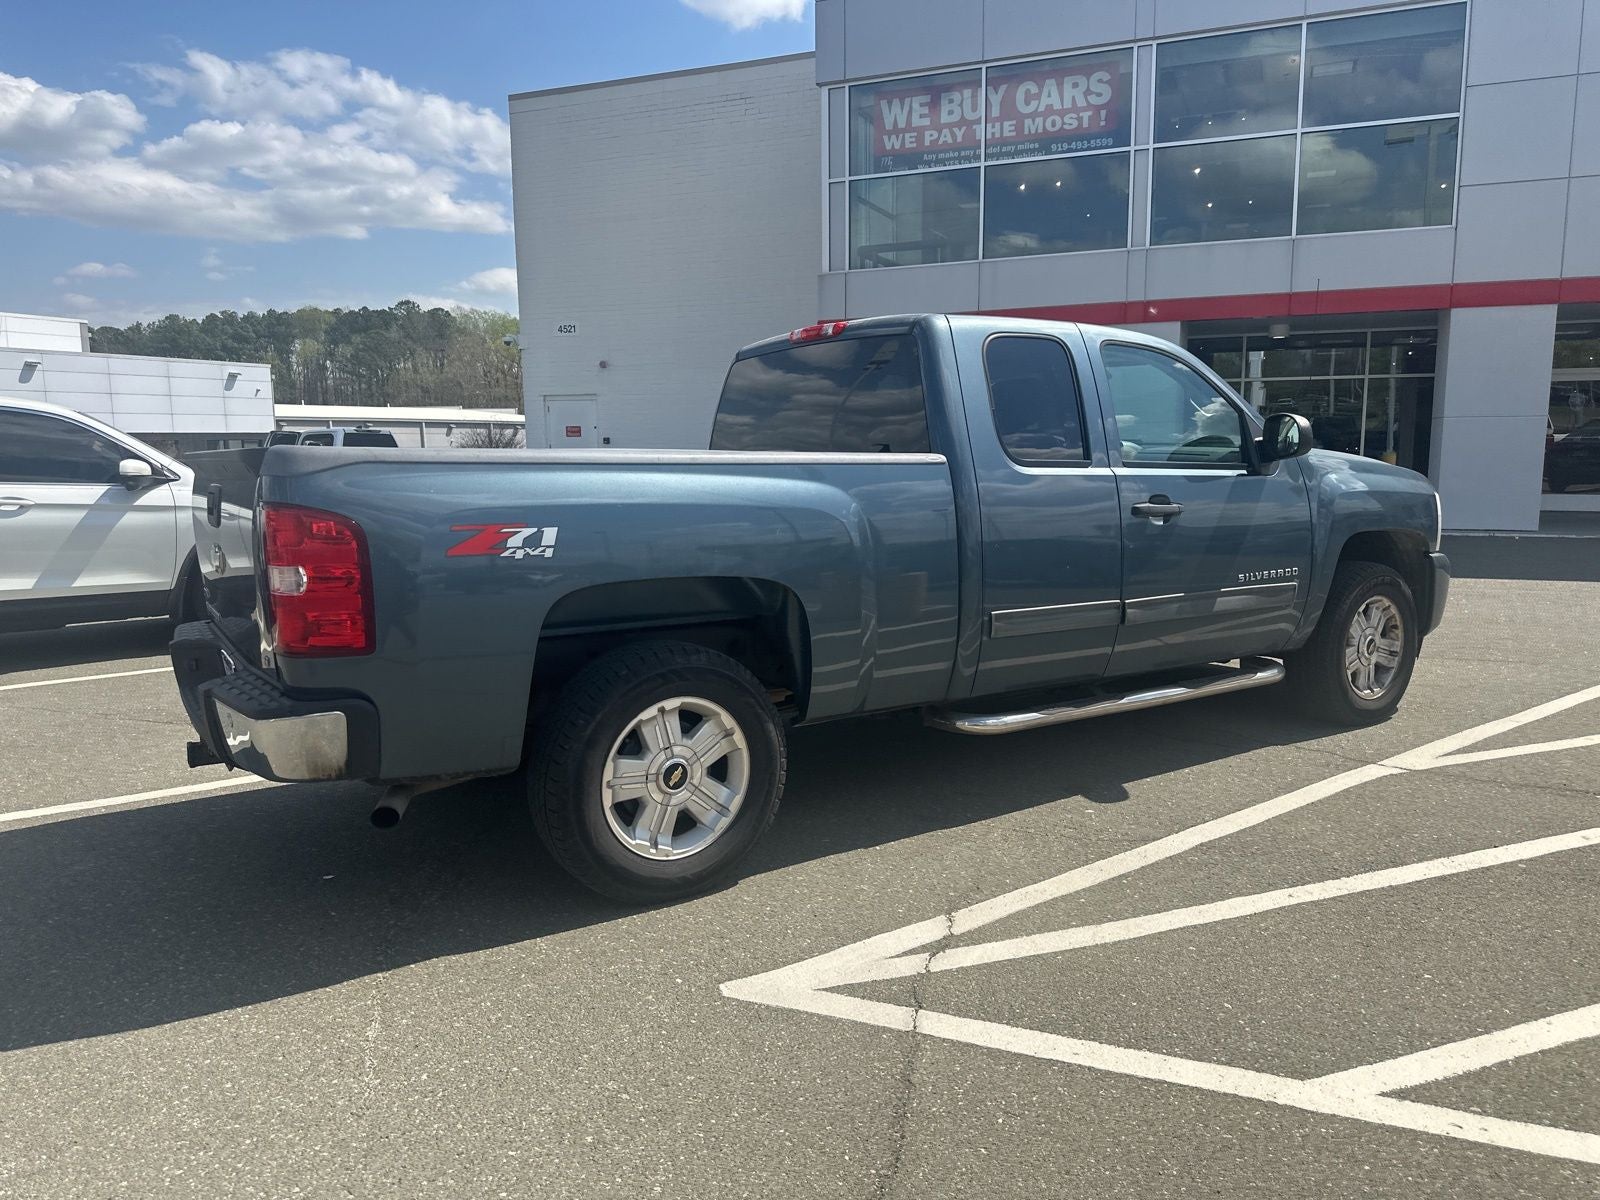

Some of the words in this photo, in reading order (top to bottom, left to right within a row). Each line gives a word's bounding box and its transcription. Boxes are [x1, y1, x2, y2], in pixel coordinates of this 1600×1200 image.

[880, 95, 931, 130] WE
[940, 83, 1008, 124] BUY
[1016, 71, 1112, 113] CARS
[883, 132, 917, 150] WE
[924, 126, 966, 146] PAY
[973, 120, 1016, 140] THE
[1024, 110, 1093, 135] MOST
[923, 153, 938, 162] Any
[938, 151, 959, 160] make
[960, 149, 974, 158] any
[976, 146, 1000, 156] mdel
[1001, 145, 1015, 154] any
[1017, 141, 1039, 151] miles
[1051, 137, 1113, 152] 919-493-5599
[557, 325, 576, 334] 4521
[445, 522, 558, 558] Z71
[1238, 567, 1299, 583] SILVERADO
